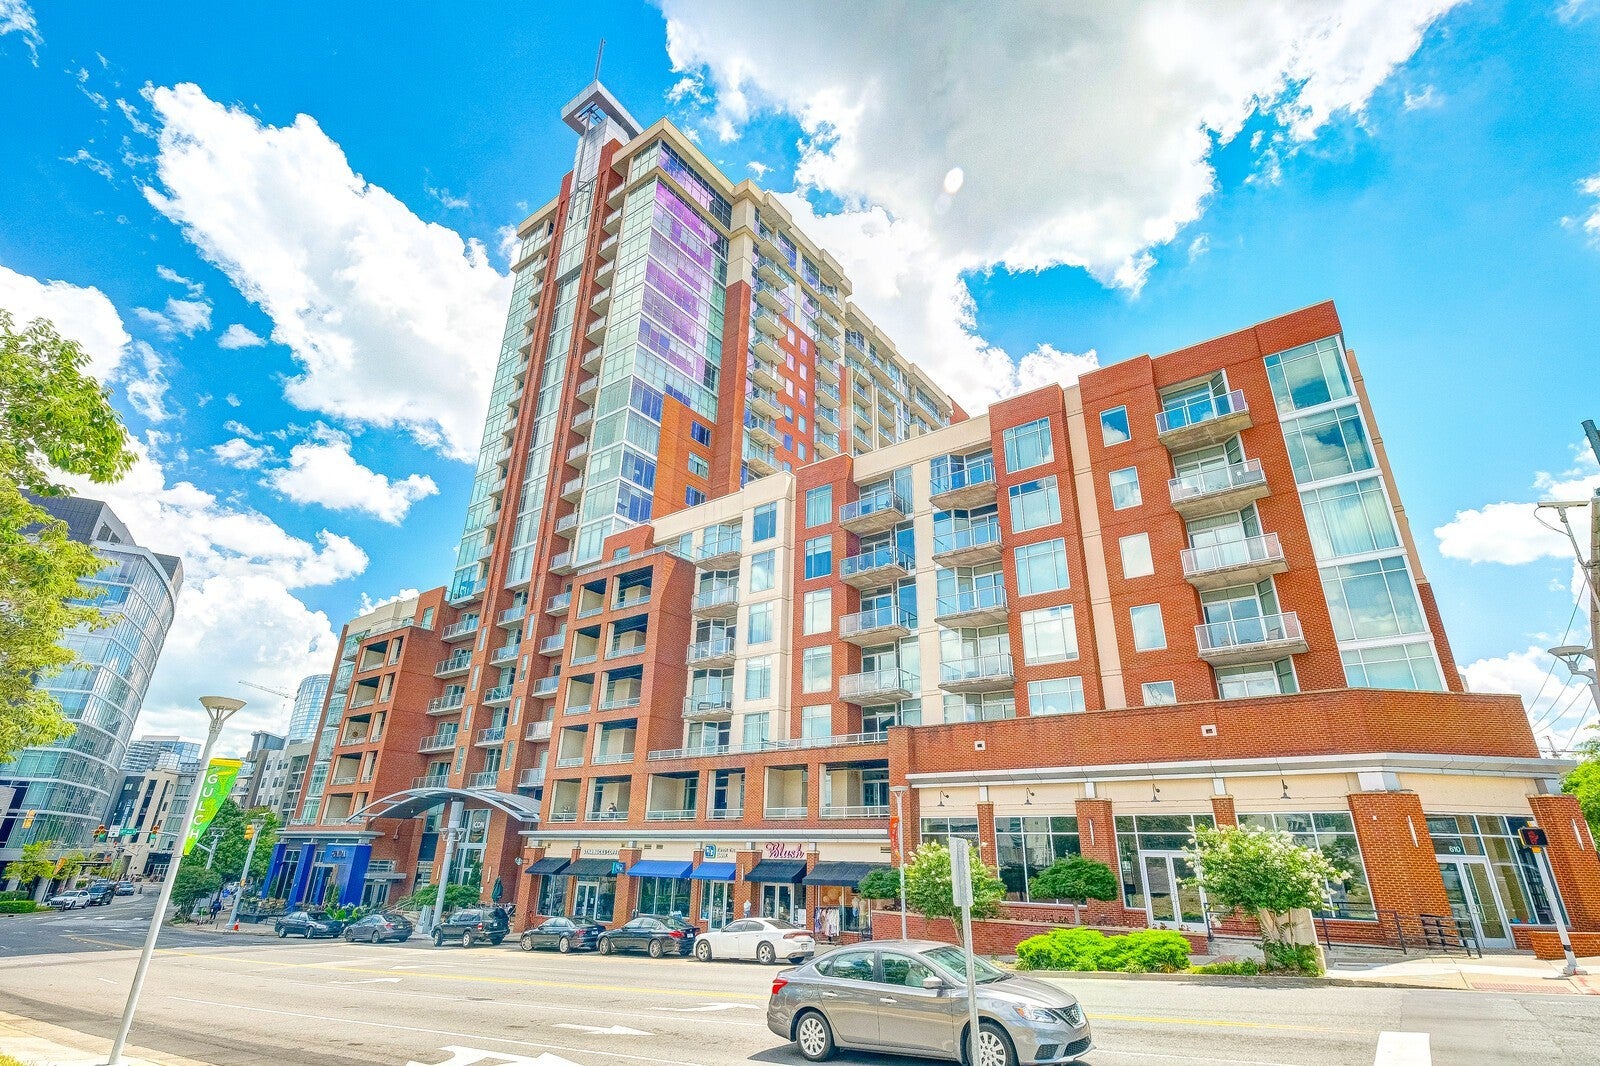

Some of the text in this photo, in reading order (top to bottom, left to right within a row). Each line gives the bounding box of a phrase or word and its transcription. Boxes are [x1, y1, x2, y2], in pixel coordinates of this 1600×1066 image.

[189, 774, 218, 839] GULCH
[765, 841, 805, 859] Blush
[1449, 845, 1461, 853] 610
